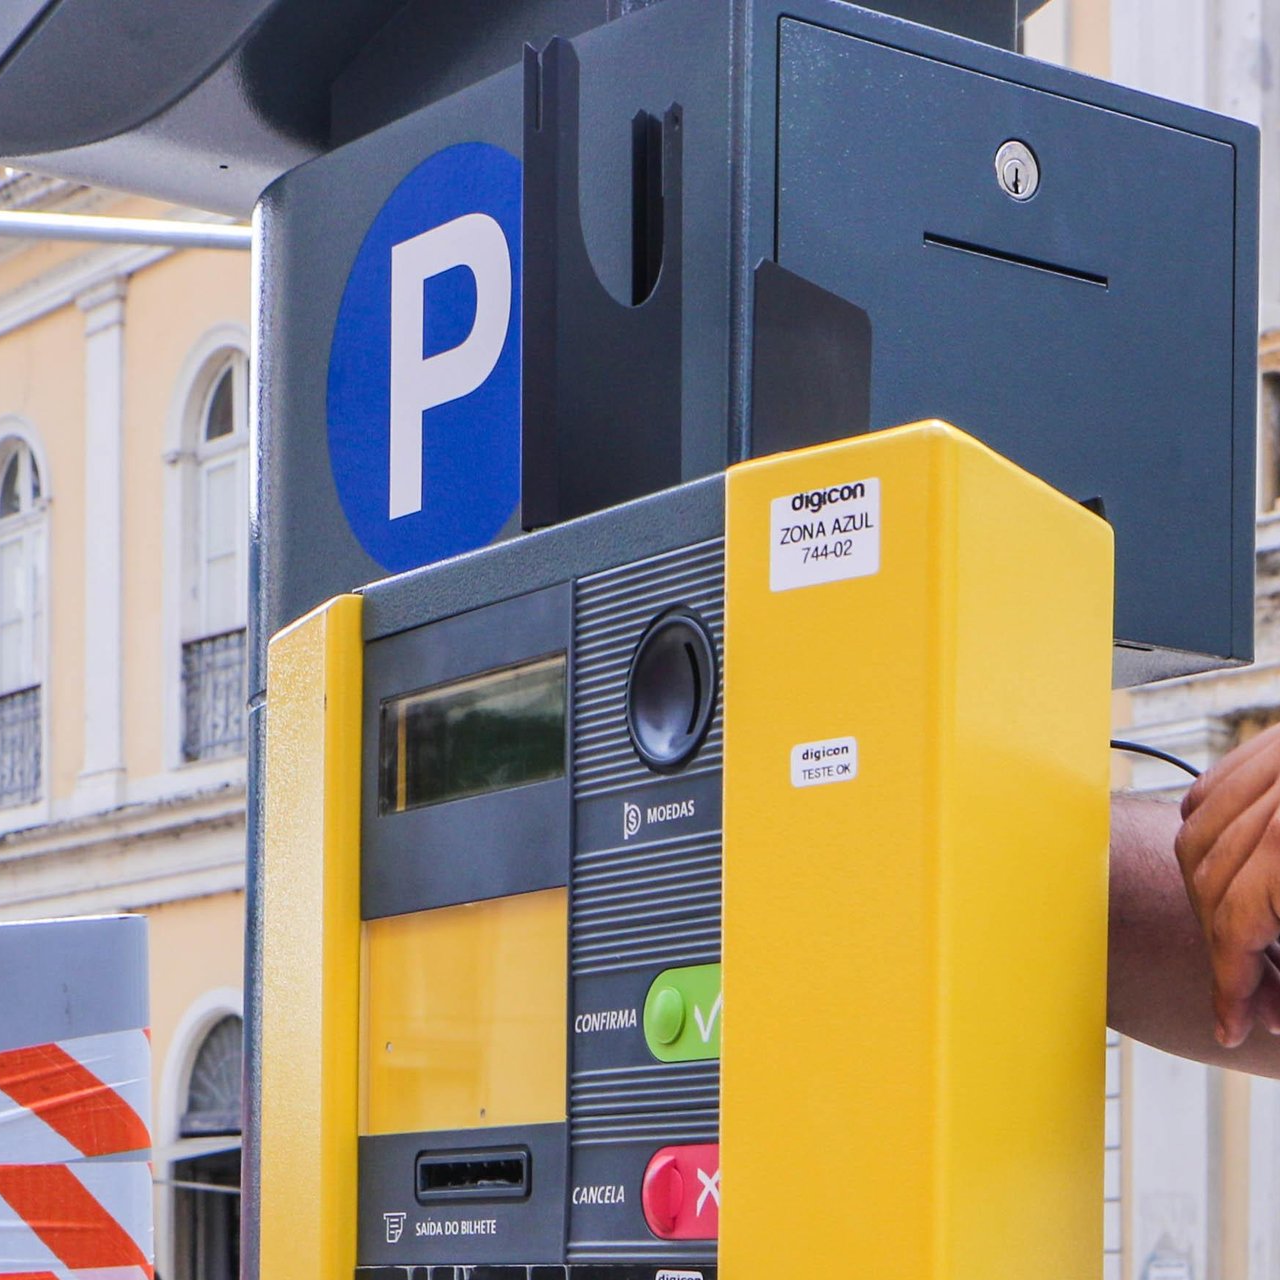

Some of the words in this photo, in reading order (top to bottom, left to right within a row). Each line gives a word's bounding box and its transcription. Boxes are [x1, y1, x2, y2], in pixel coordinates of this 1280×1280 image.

[389, 212, 512, 521] P
[791, 481, 865, 513] digicon
[780, 521, 827, 545] ZONA
[831, 512, 874, 535] AZUL
[801, 539, 853, 564] 744-02
[801, 744, 849, 762] digicon
[802, 765, 834, 780] TESTE
[836, 762, 851, 775] OK
[647, 800, 695, 824] MOEDAS
[575, 1008, 638, 1033] CONFIRMA
[572, 1185, 625, 1206] CANCELA
[415, 1217, 442, 1237] SAÍDA
[445, 1221, 459, 1236] DO
[461, 1219, 497, 1236] BILHETE
